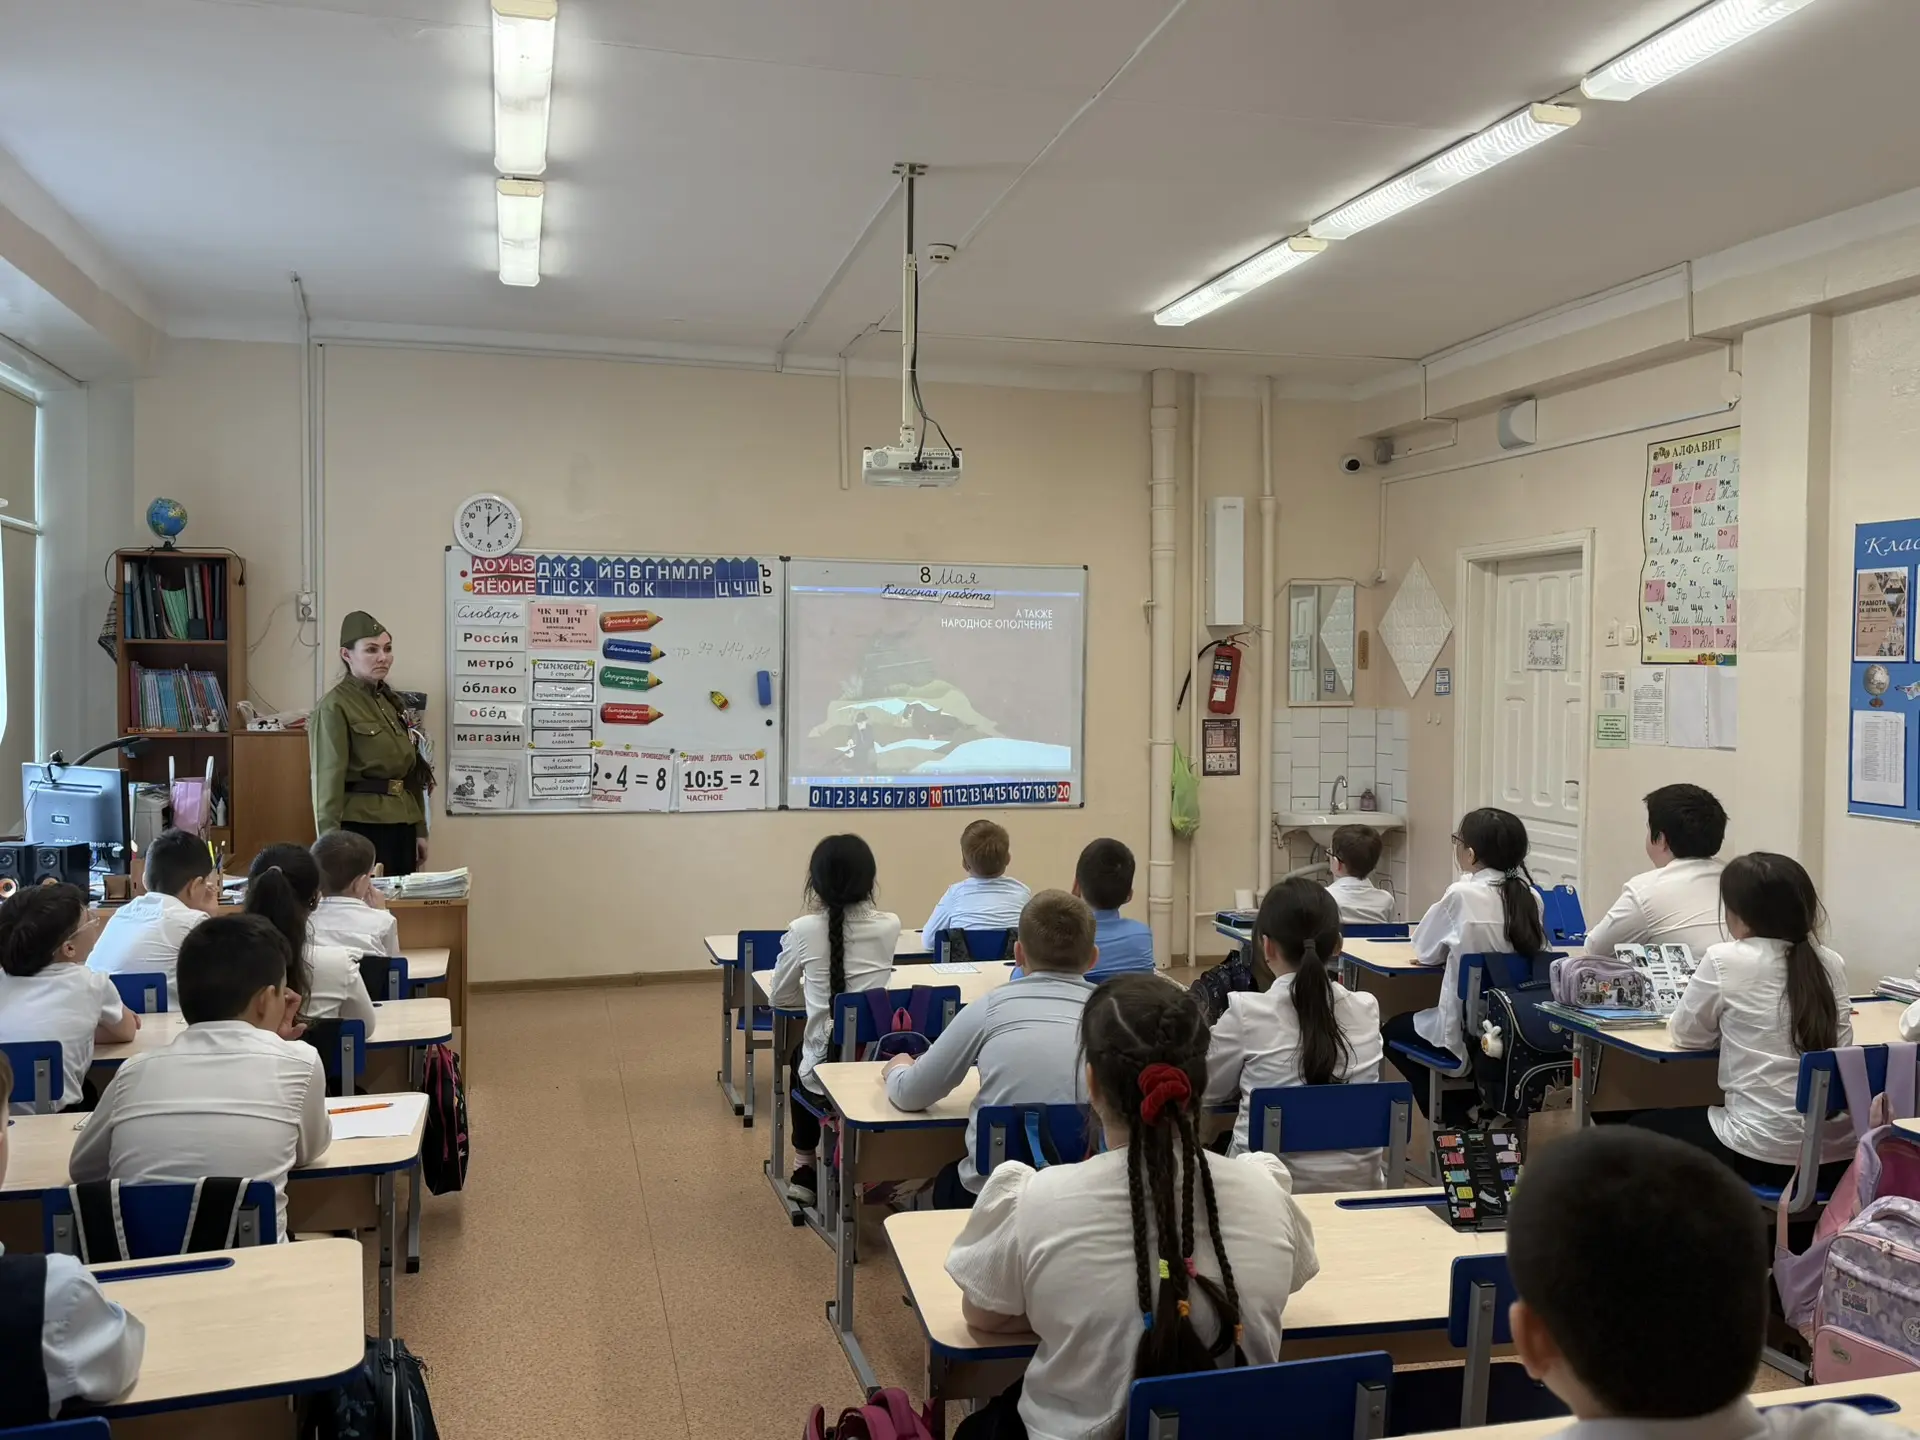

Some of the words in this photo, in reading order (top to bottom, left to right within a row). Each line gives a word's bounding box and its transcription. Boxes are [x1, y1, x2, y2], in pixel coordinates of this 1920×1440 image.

[1672, 439, 1722, 457] АЛФАВИТ
[759, 564, 771, 577] Ъ
[920, 567, 931, 583] 8
[935, 568, 979, 585] Мая
[763, 582, 772, 594] Ь
[882, 584, 938, 597] Классная
[458, 605, 520, 624] Словарь
[1016, 610, 1022, 618] А
[1024, 610, 1053, 618] ТАКЖЕ
[604, 617, 630, 627] Русский
[941, 620, 992, 629] НАРОДНОЕ
[995, 620, 1053, 629] ОПОЛЧЕНИЕ
[607, 645, 651, 654] Математика
[604, 672, 648, 682] Окружающий
[616, 765, 627, 788] 4
[636, 775, 648, 784] =
[656, 768, 666, 791] 8
[685, 770, 723, 788] 10:5
[730, 775, 741, 783] =
[749, 769, 759, 786] 2
[812, 790, 819, 804] 0
[825, 791, 830, 804] 1
[836, 790, 843, 804] 2
[848, 791, 855, 804] 3
[860, 791, 867, 804] 4
[872, 791, 879, 804] 5
[884, 791, 891, 804] 6
[897, 792, 903, 804] 7
[908, 791, 915, 804] 8
[920, 791, 927, 804] 9
[931, 790, 940, 804] 10
[943, 789, 953, 803] 11
[956, 789, 967, 802] 12
[970, 788, 980, 802] 13
[982, 788, 993, 801] 14
[995, 786, 1006, 800] 15
[1008, 786, 1019, 800] 16
[1021, 786, 1031, 799] 17
[1034, 786, 1045, 799] 18
[1047, 785, 1056, 798] 19
[1058, 785, 1069, 799] 20
[1510, 1134, 1518, 1145] 6
[1442, 1154, 1450, 1165] 2
[1444, 1171, 1452, 1182] 3
[1452, 1206, 1460, 1218] 5
